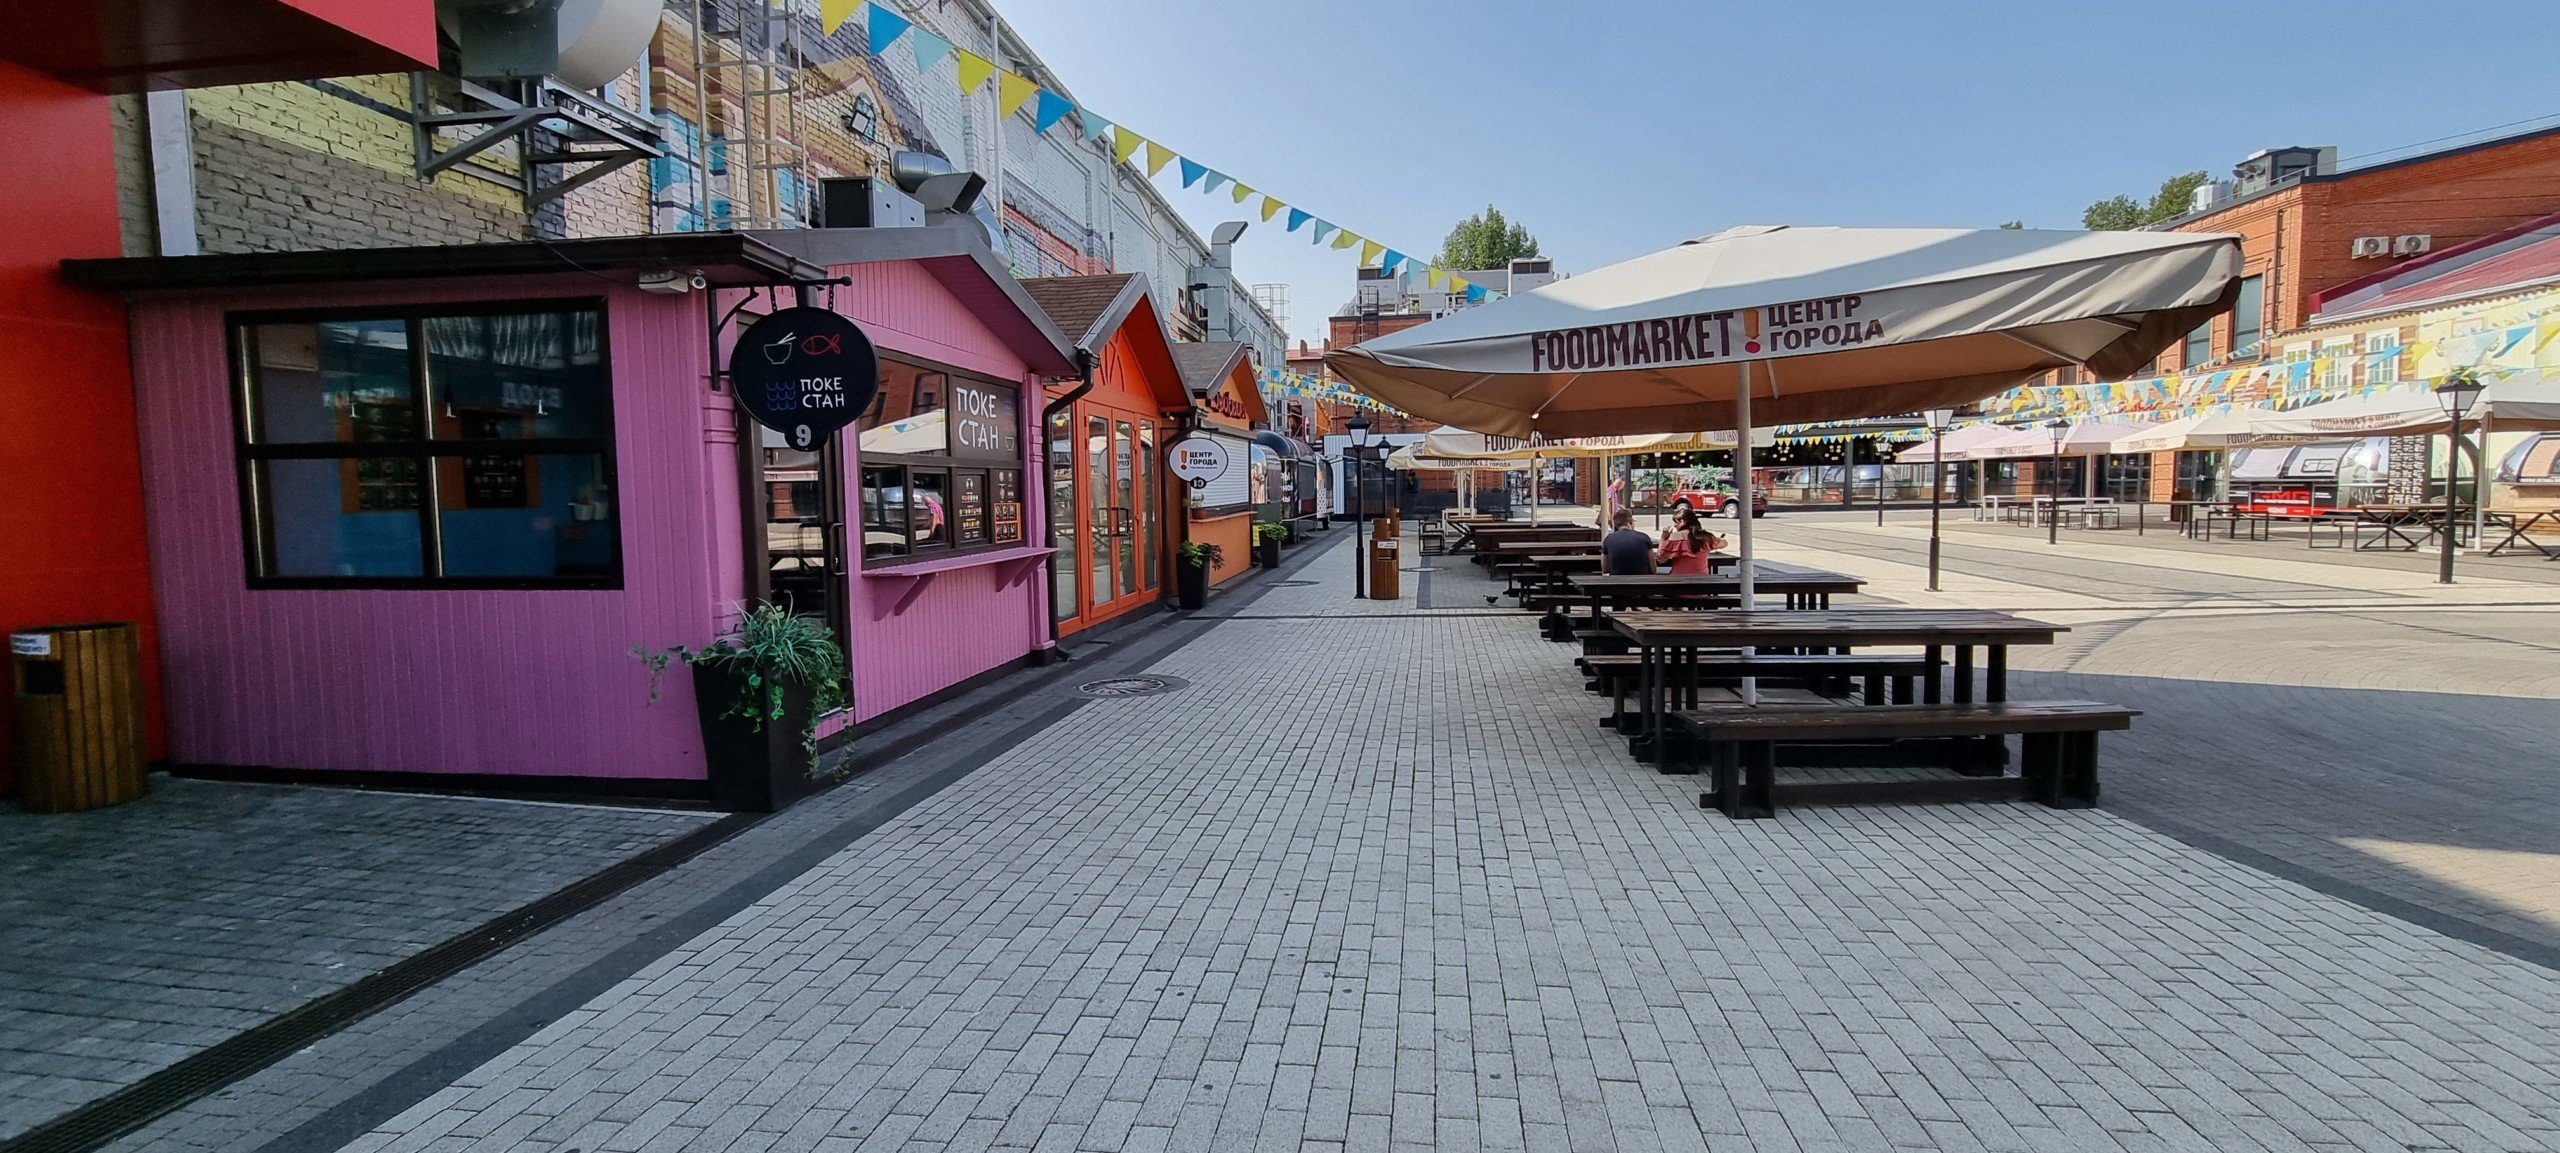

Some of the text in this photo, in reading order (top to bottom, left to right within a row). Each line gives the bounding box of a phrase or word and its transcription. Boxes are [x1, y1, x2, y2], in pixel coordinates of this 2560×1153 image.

[1767, 295, 1862, 328] ЦЕНТР
[1531, 311, 1734, 373] FOODMARKET
[1769, 319, 1886, 353] ГОРОДА
[800, 377, 842, 392] ПОКЕ
[802, 392, 845, 409] СТАН
[955, 386, 997, 419] ПОКЕ
[796, 424, 812, 446] 9
[957, 418, 1000, 451] СТАН
[1189, 458, 1218, 466] ГОРОДА
